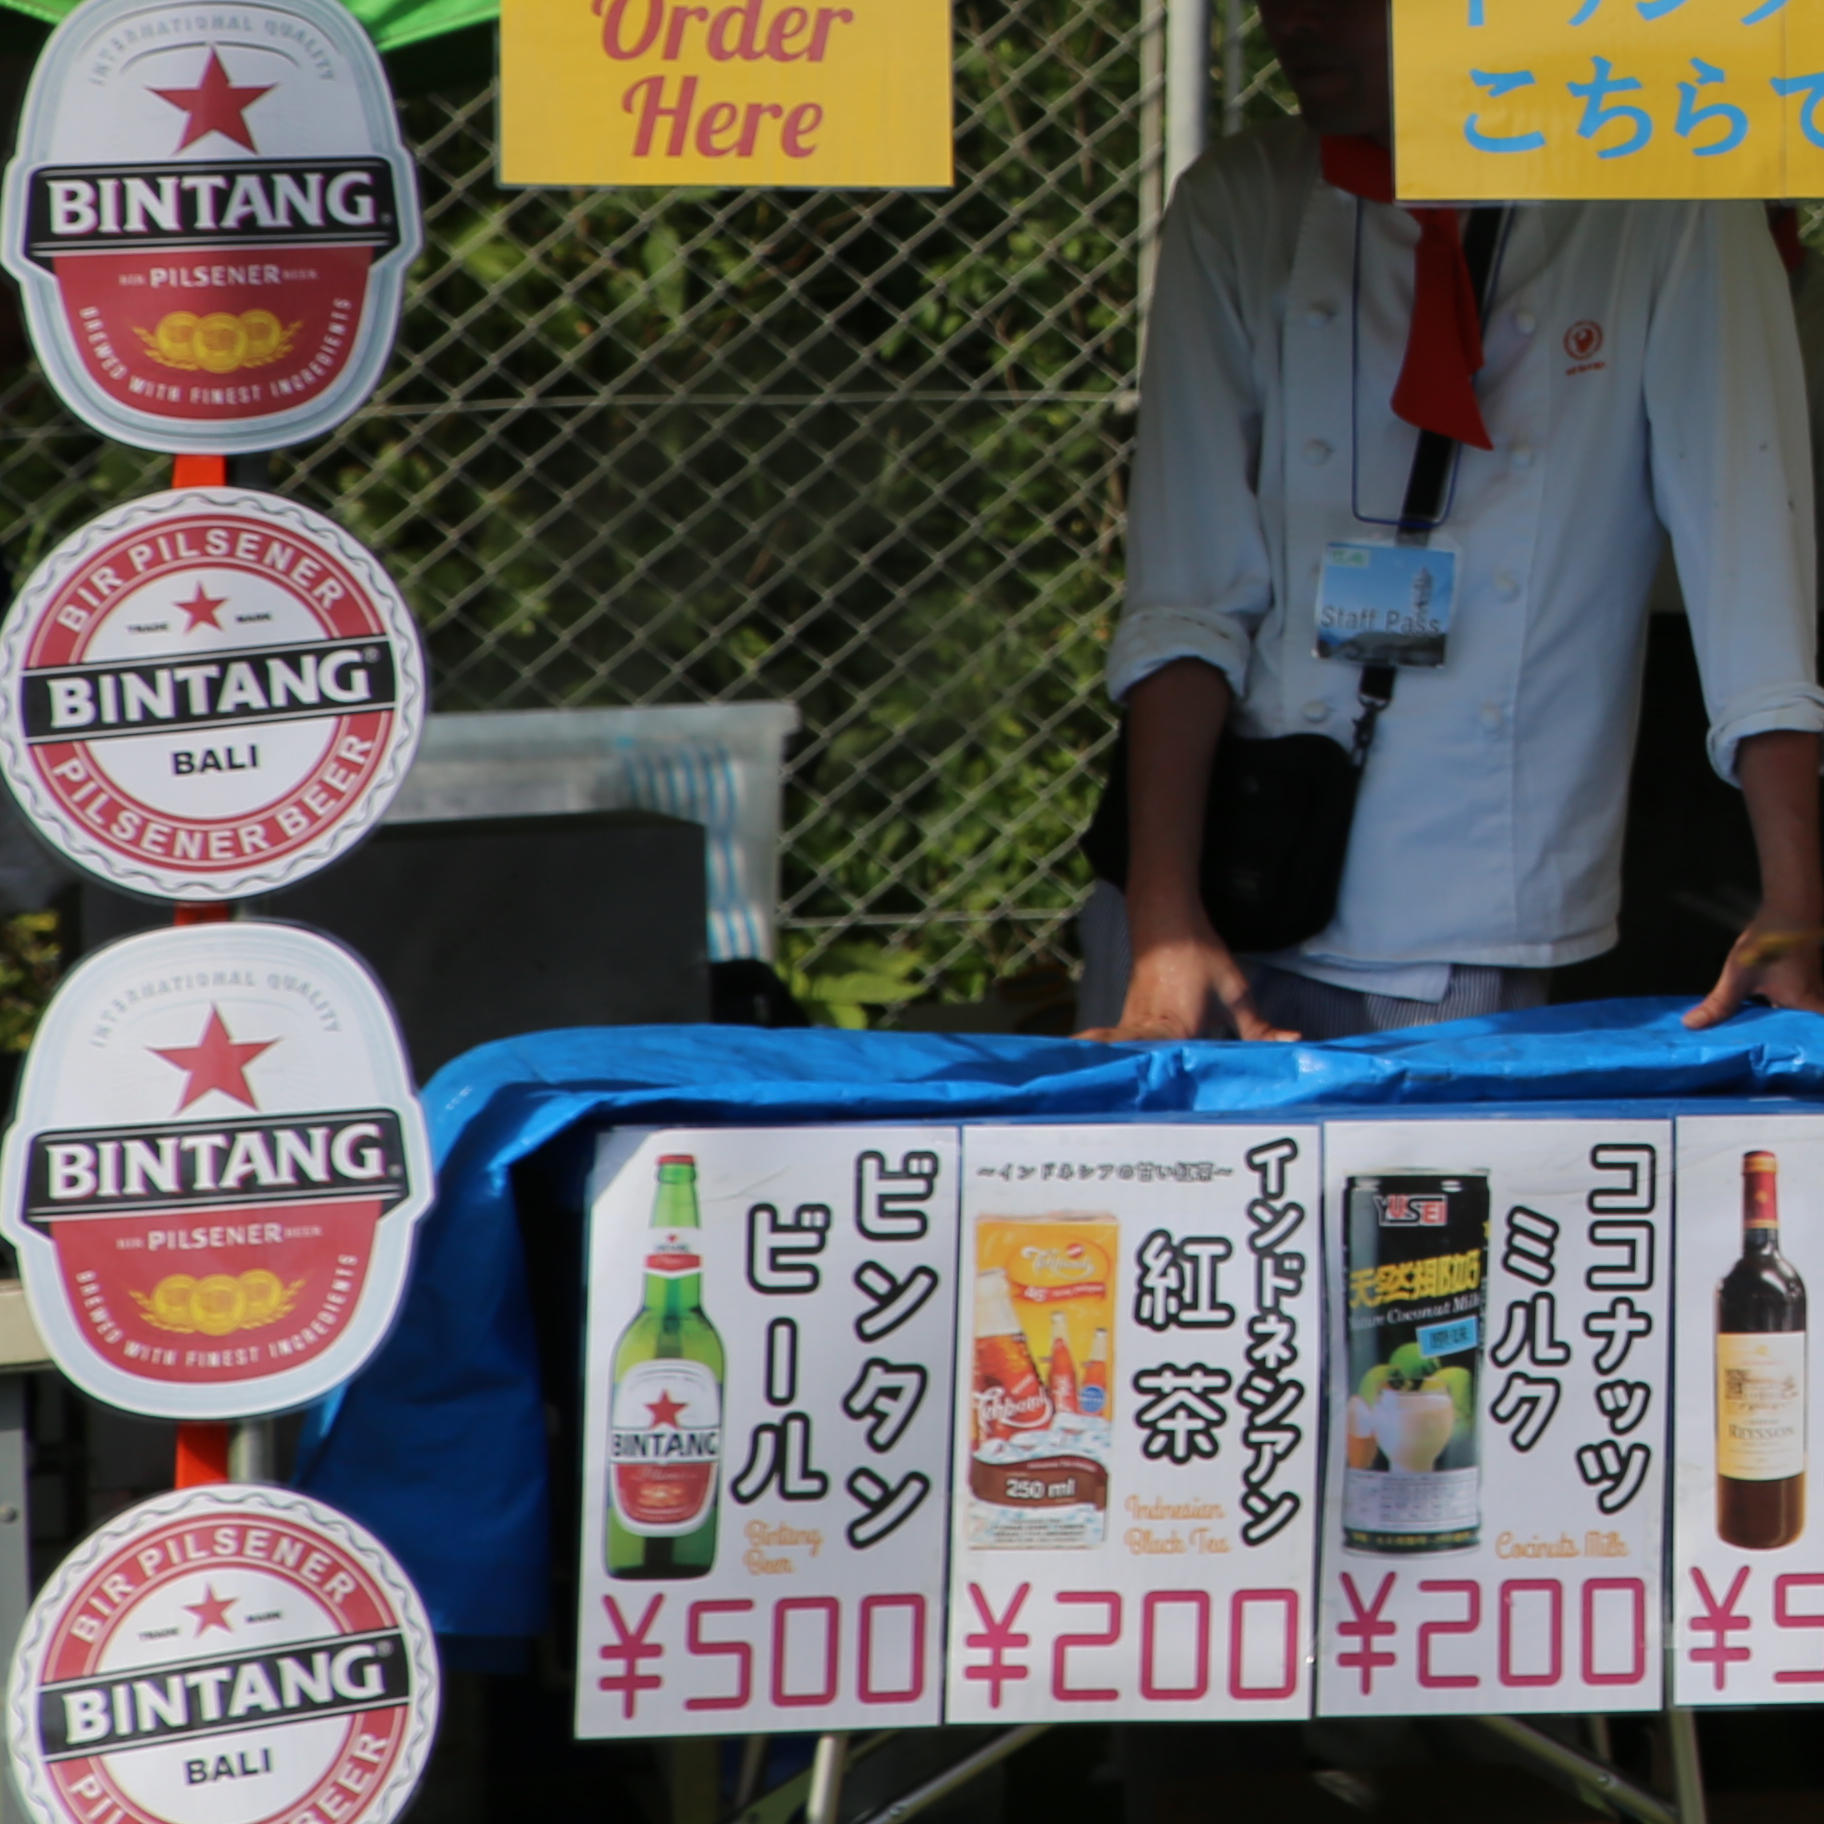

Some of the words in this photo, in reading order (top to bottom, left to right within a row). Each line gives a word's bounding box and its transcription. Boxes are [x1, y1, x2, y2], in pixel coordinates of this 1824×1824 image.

[89, 13, 254, 85] INTERNATIONAL
[265, 19, 335, 82] QUALITY
[621, 75, 824, 159] Here
[48, 172, 380, 235] BINTANG
[150, 265, 282, 288] PILSENER
[79, 306, 128, 381] BREWED
[128, 376, 181, 402] WITH
[191, 385, 262, 405] FINEST
[272, 297, 352, 399] INGREDIENTS
[57, 567, 124, 634] BIR
[128, 528, 347, 609] PILSENER
[1321, 605, 1377, 629] Staff
[1386, 610, 1439, 636] Pass
[47, 650, 371, 729] BINTANG
[53, 758, 271, 861] PILSENER
[277, 733, 374, 839] BEER
[171, 744, 260, 776] BALI
[91, 973, 257, 1048] INTERNATIONAL
[268, 973, 340, 1034] QUALITY
[47, 1124, 386, 1201] BINTANG
[148, 1223, 283, 1251] PILSENER
[76, 1270, 122, 1345] BREWED
[124, 1340, 175, 1366] WITH
[186, 1345, 260, 1367] FINEST
[270, 1254, 359, 1359] INGREDIENTS
[731, 1204, 830, 1505] ビール
[844, 1150, 939, 1550] ビンタン
[1134, 1229, 1235, 1463] 紅茶
[1237, 1137, 1306, 1547] インドネシアン
[1490, 1205, 1571, 1451] ミルク
[1576, 1143, 1656, 1514] ココナッツ
[1006, 1479, 1044, 1498] 250
[1048, 1478, 1075, 1497] ml
[70, 1573, 136, 1643] BIR
[139, 1526, 357, 1604] PILSENER
[1337, 1571, 1646, 1695] ¥200
[62, 1645, 385, 1744] BINTANG
[599, 1593, 926, 1718] ¥500
[965, 1582, 1298, 1708] ¥200
[184, 1749, 272, 1785] BALI
